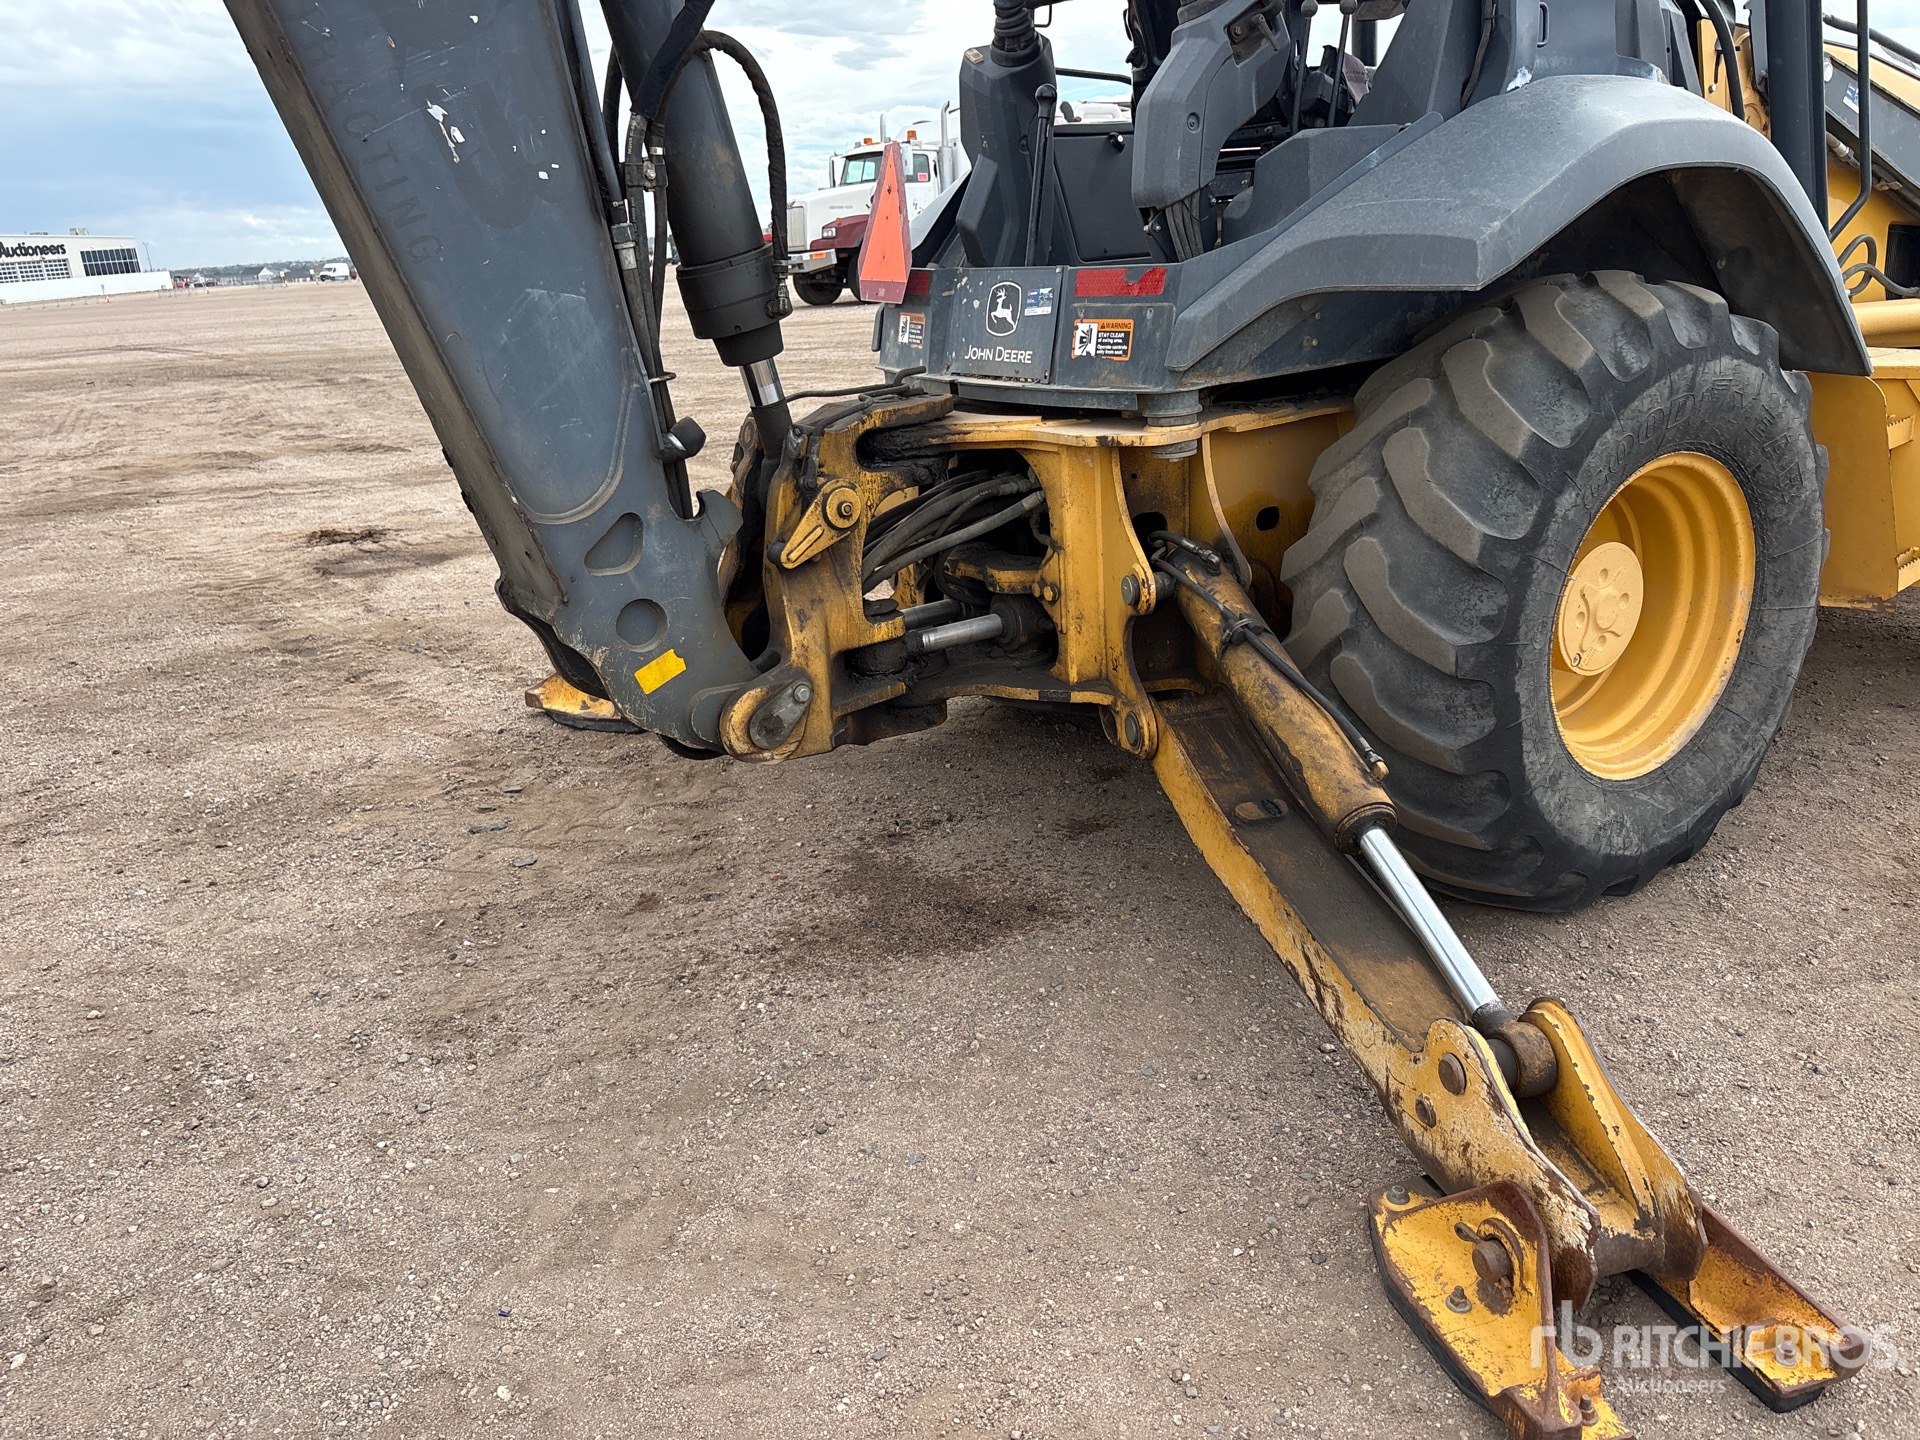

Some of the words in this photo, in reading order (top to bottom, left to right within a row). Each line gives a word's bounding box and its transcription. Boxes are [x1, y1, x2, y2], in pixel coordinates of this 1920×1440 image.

[0, 241, 67, 259] Auctioneers
[964, 344, 994, 362] JOHN
[995, 346, 1033, 364] DEERE
